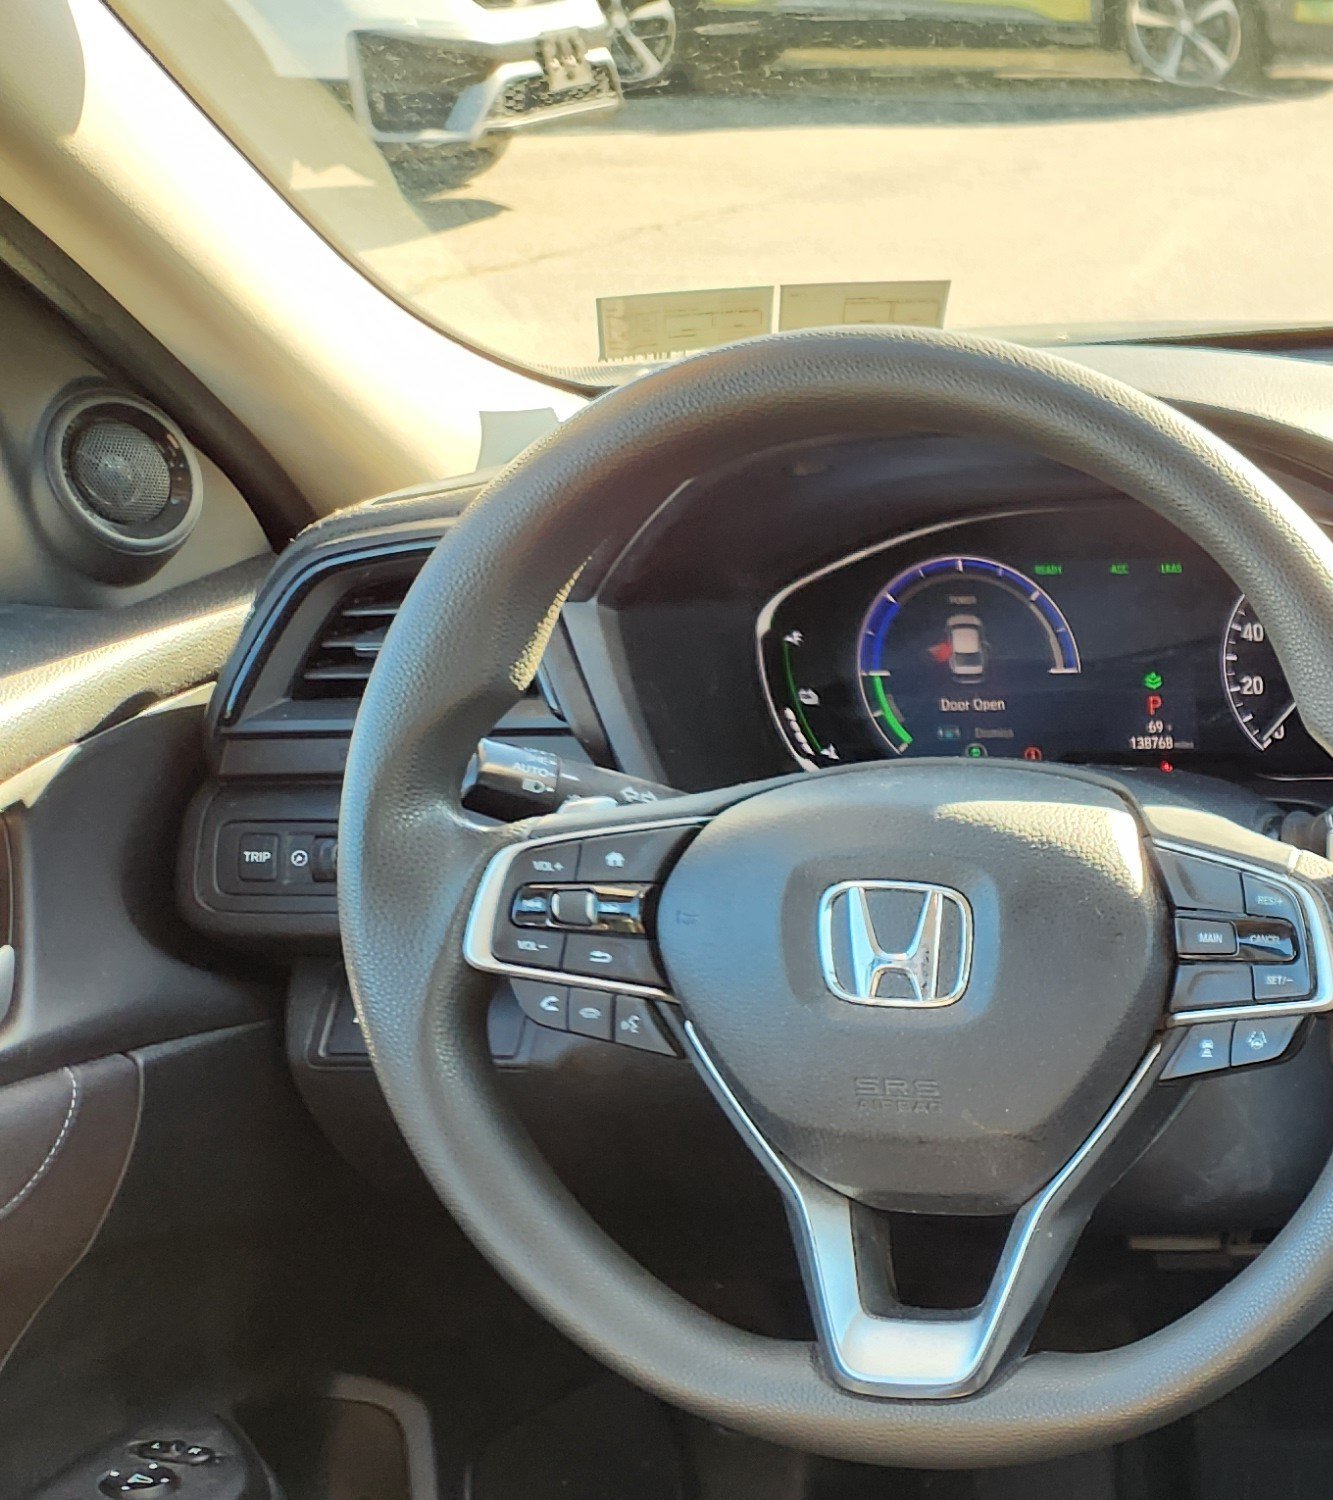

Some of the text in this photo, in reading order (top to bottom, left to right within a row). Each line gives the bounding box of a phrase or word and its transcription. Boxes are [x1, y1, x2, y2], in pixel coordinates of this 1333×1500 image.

[1241, 623, 1264, 642] 40
[1240, 676, 1263, 695] 20
[941, 698, 1006, 712] Door Open
[1147, 695, 1162, 715] P
[1130, 736, 1174, 750] 138768
[512, 761, 550, 778] AUTO
[244, 851, 272, 862] TRIP
[1198, 932, 1222, 944] MAIN
[1249, 934, 1280, 944] CANCEL
[854, 1076, 942, 1099] SRS
